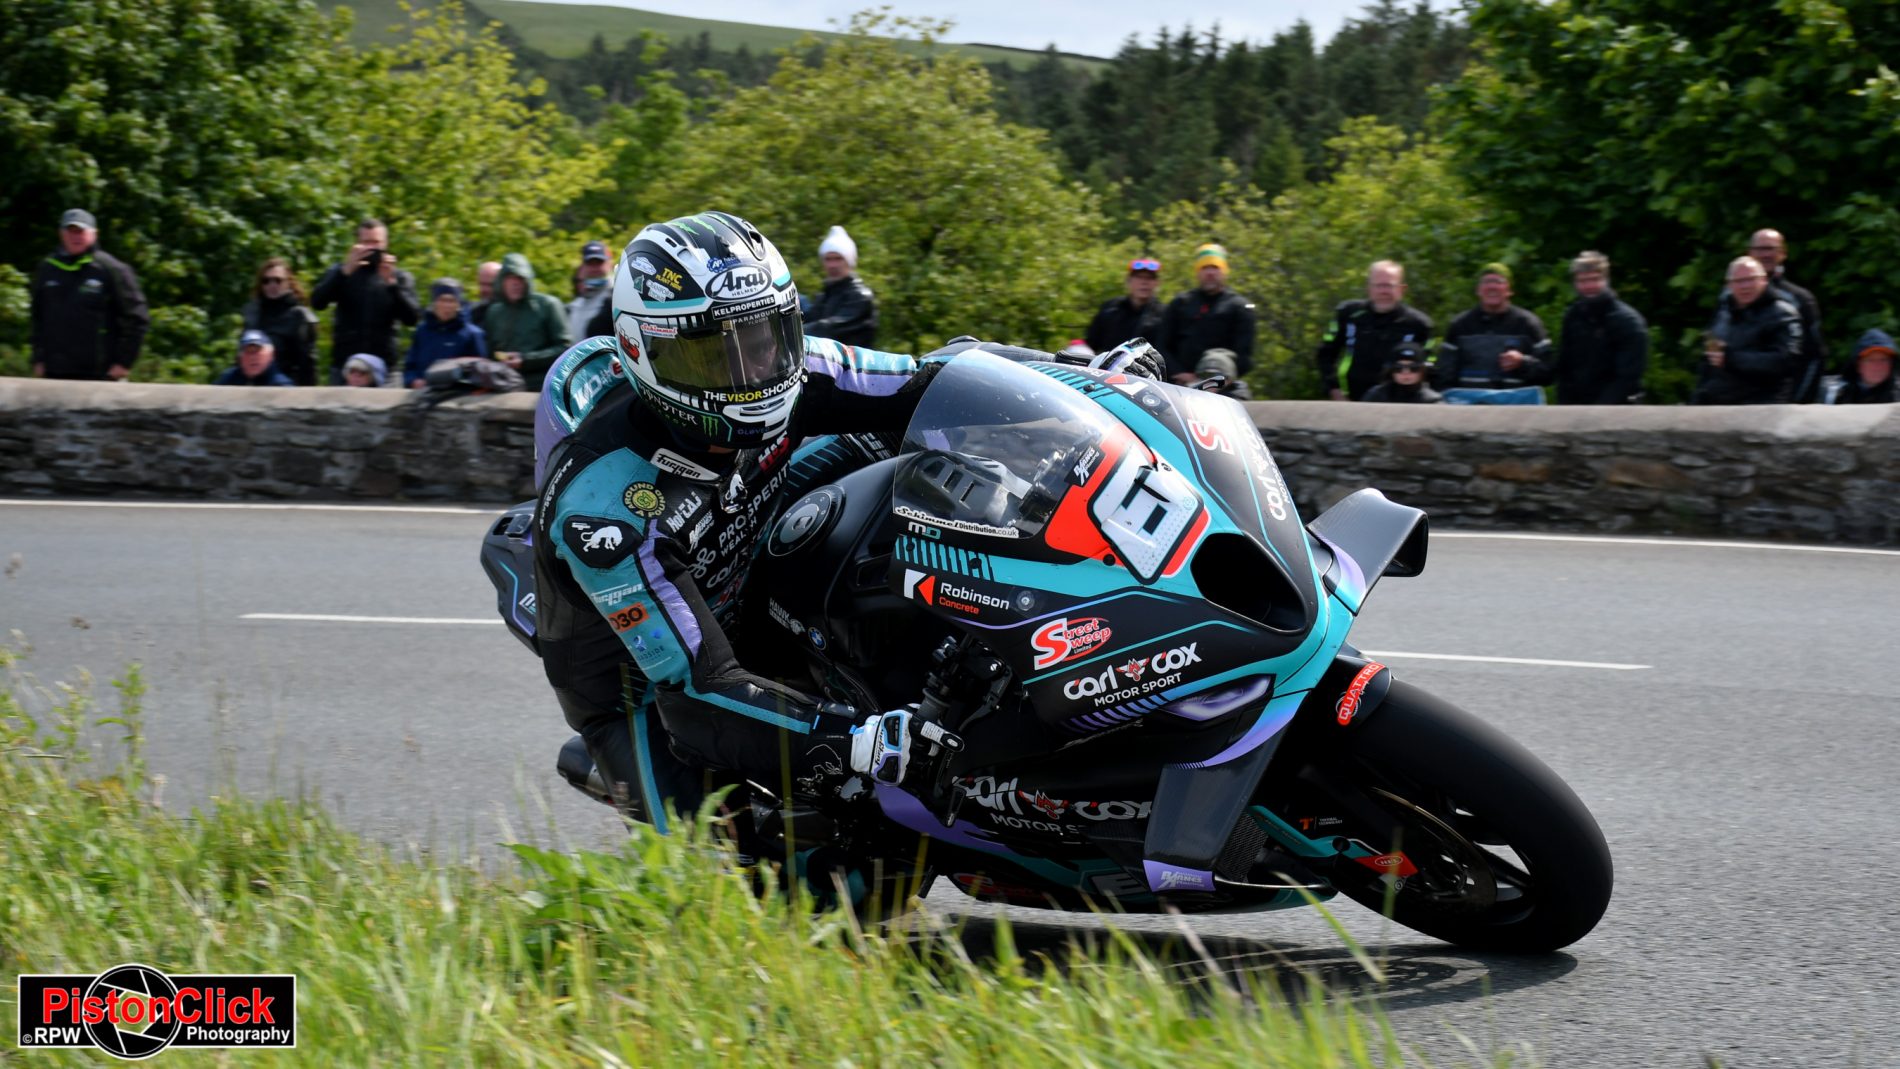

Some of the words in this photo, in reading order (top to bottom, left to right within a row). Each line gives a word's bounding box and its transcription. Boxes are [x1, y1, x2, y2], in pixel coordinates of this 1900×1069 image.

[662, 267, 683, 284] TNC
[714, 269, 766, 297] Arai
[733, 307, 778, 324] PARAMOUNT
[938, 596, 980, 616] Concrete
[940, 581, 1010, 611] Robinson
[1094, 686, 1140, 708] MOTOR
[1143, 672, 1182, 693] SPORT
[1339, 662, 1381, 720] QUATTRO
